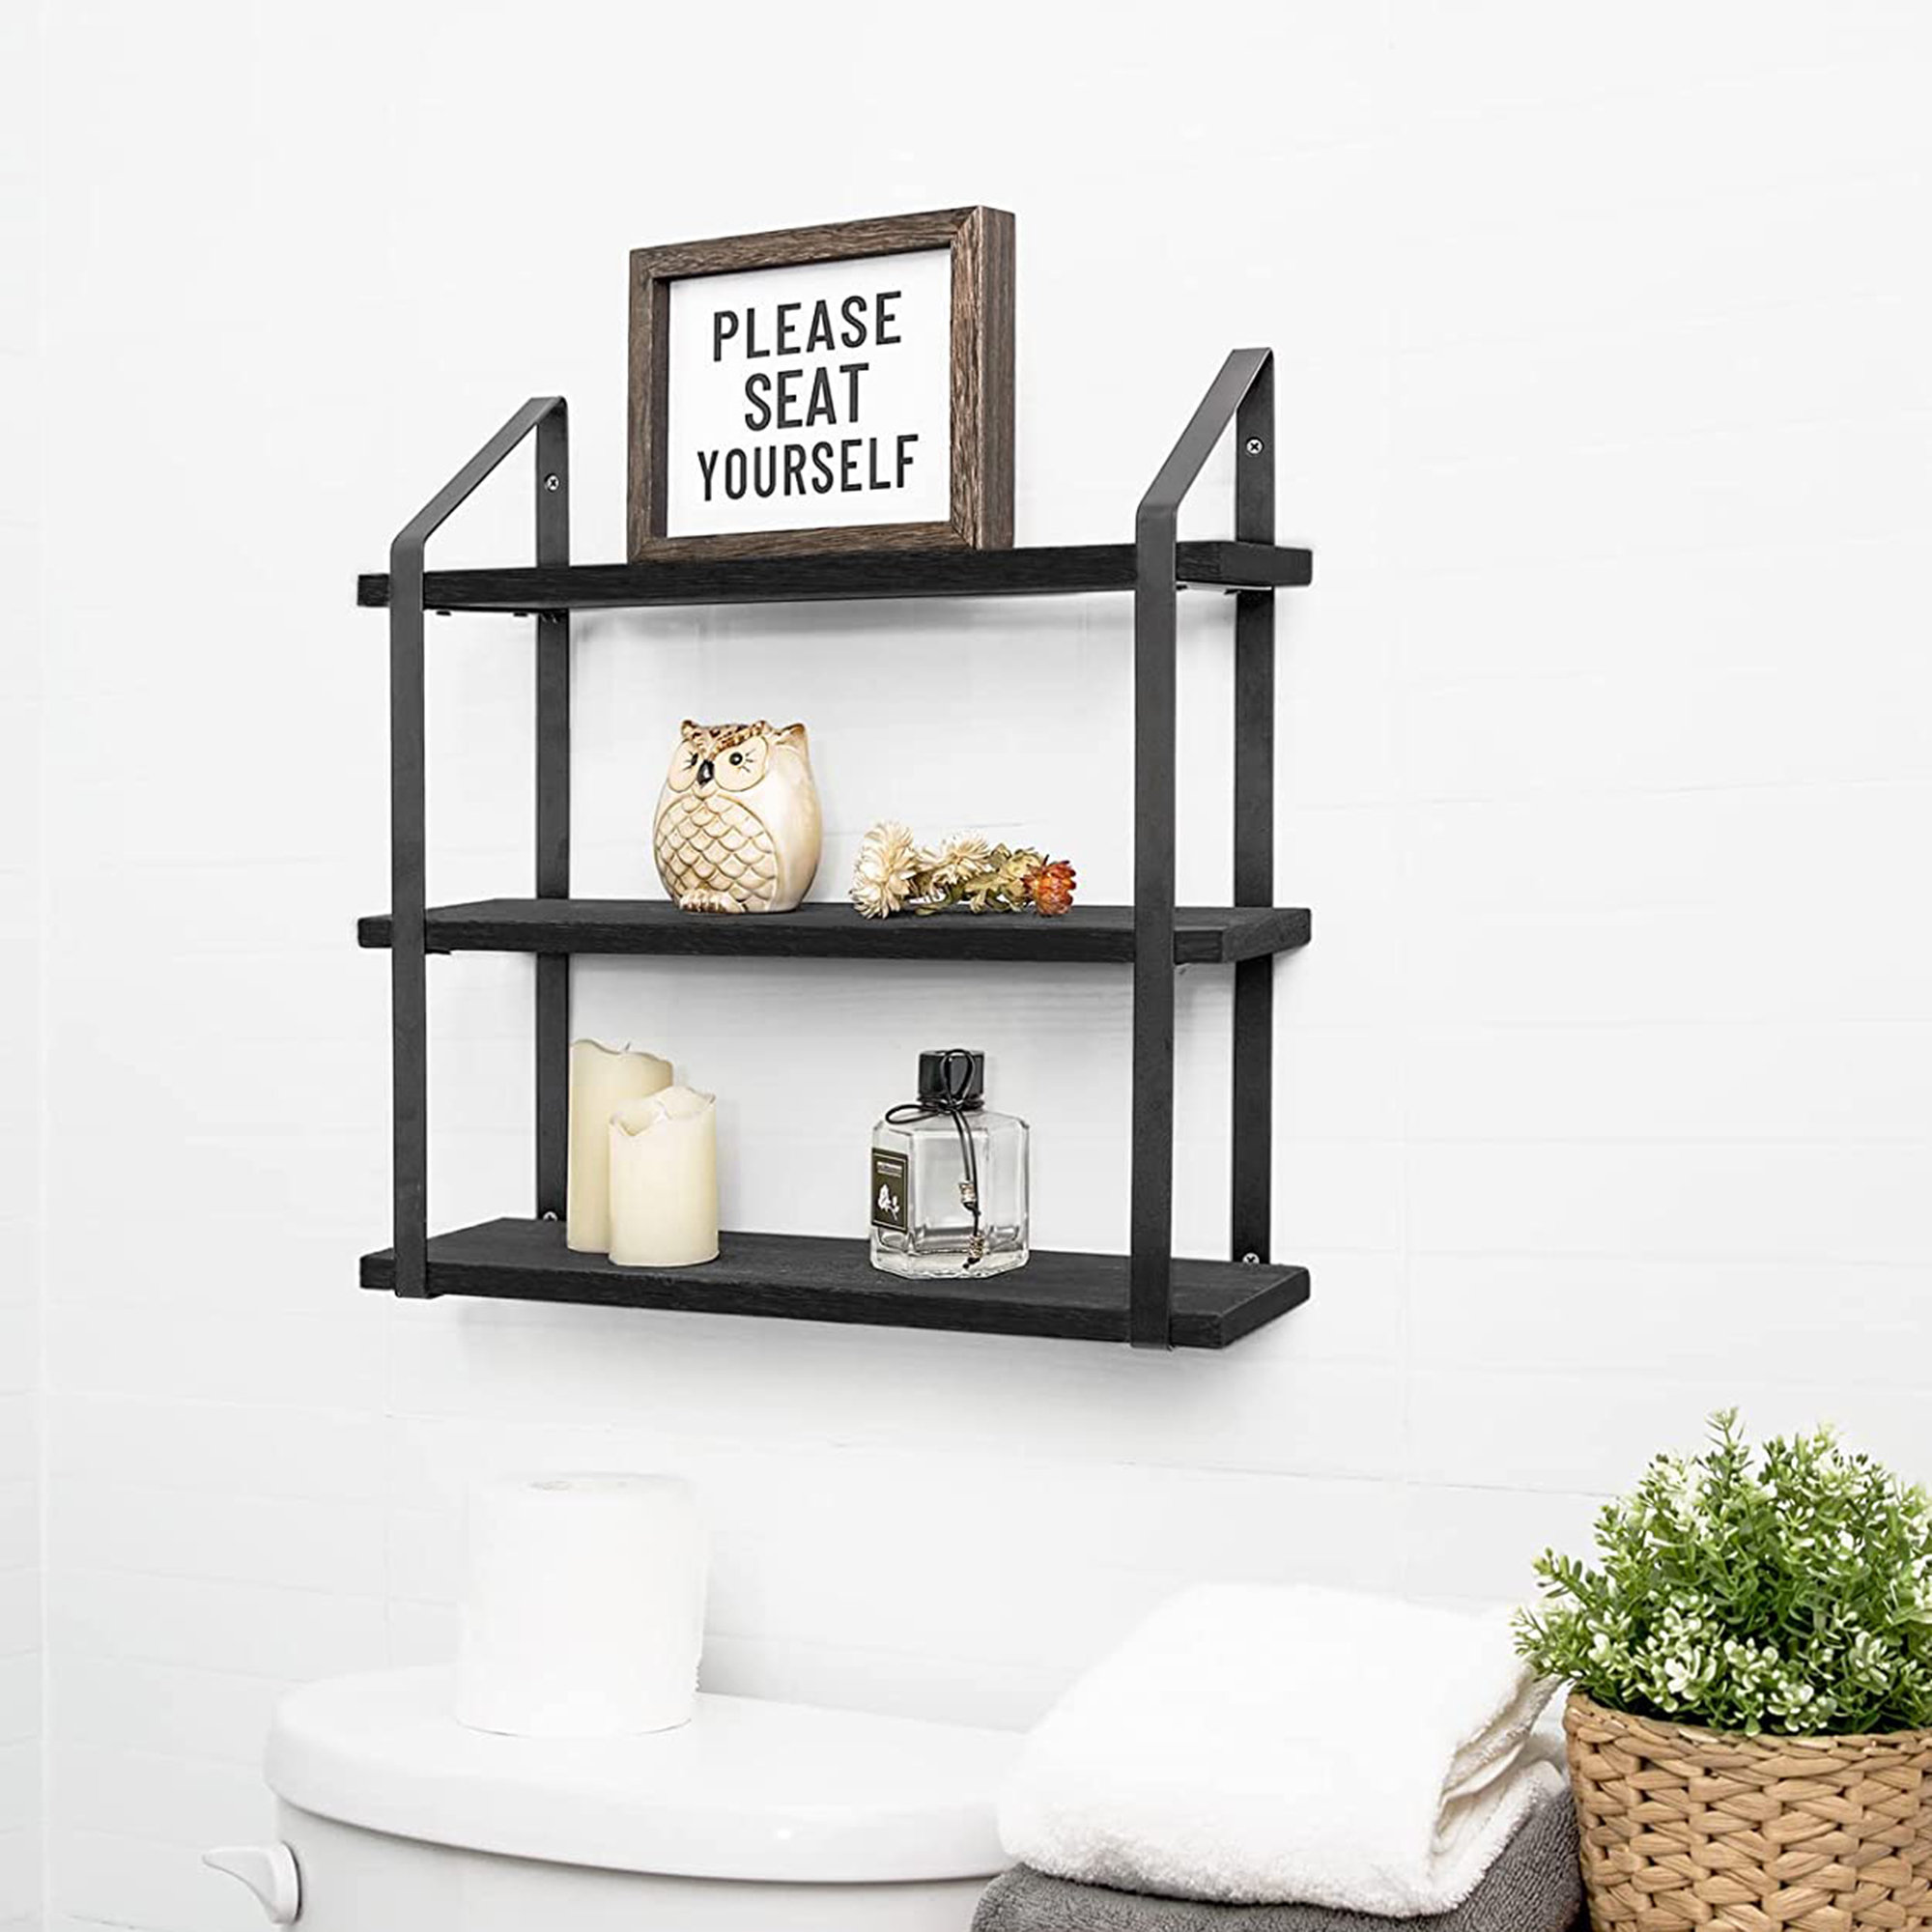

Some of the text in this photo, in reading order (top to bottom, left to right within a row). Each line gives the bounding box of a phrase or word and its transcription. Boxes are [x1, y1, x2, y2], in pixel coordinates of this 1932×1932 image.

[713, 291, 902, 362] PLEASE
[744, 362, 869, 432] SEAT
[696, 435, 919, 502] YOURSELF
